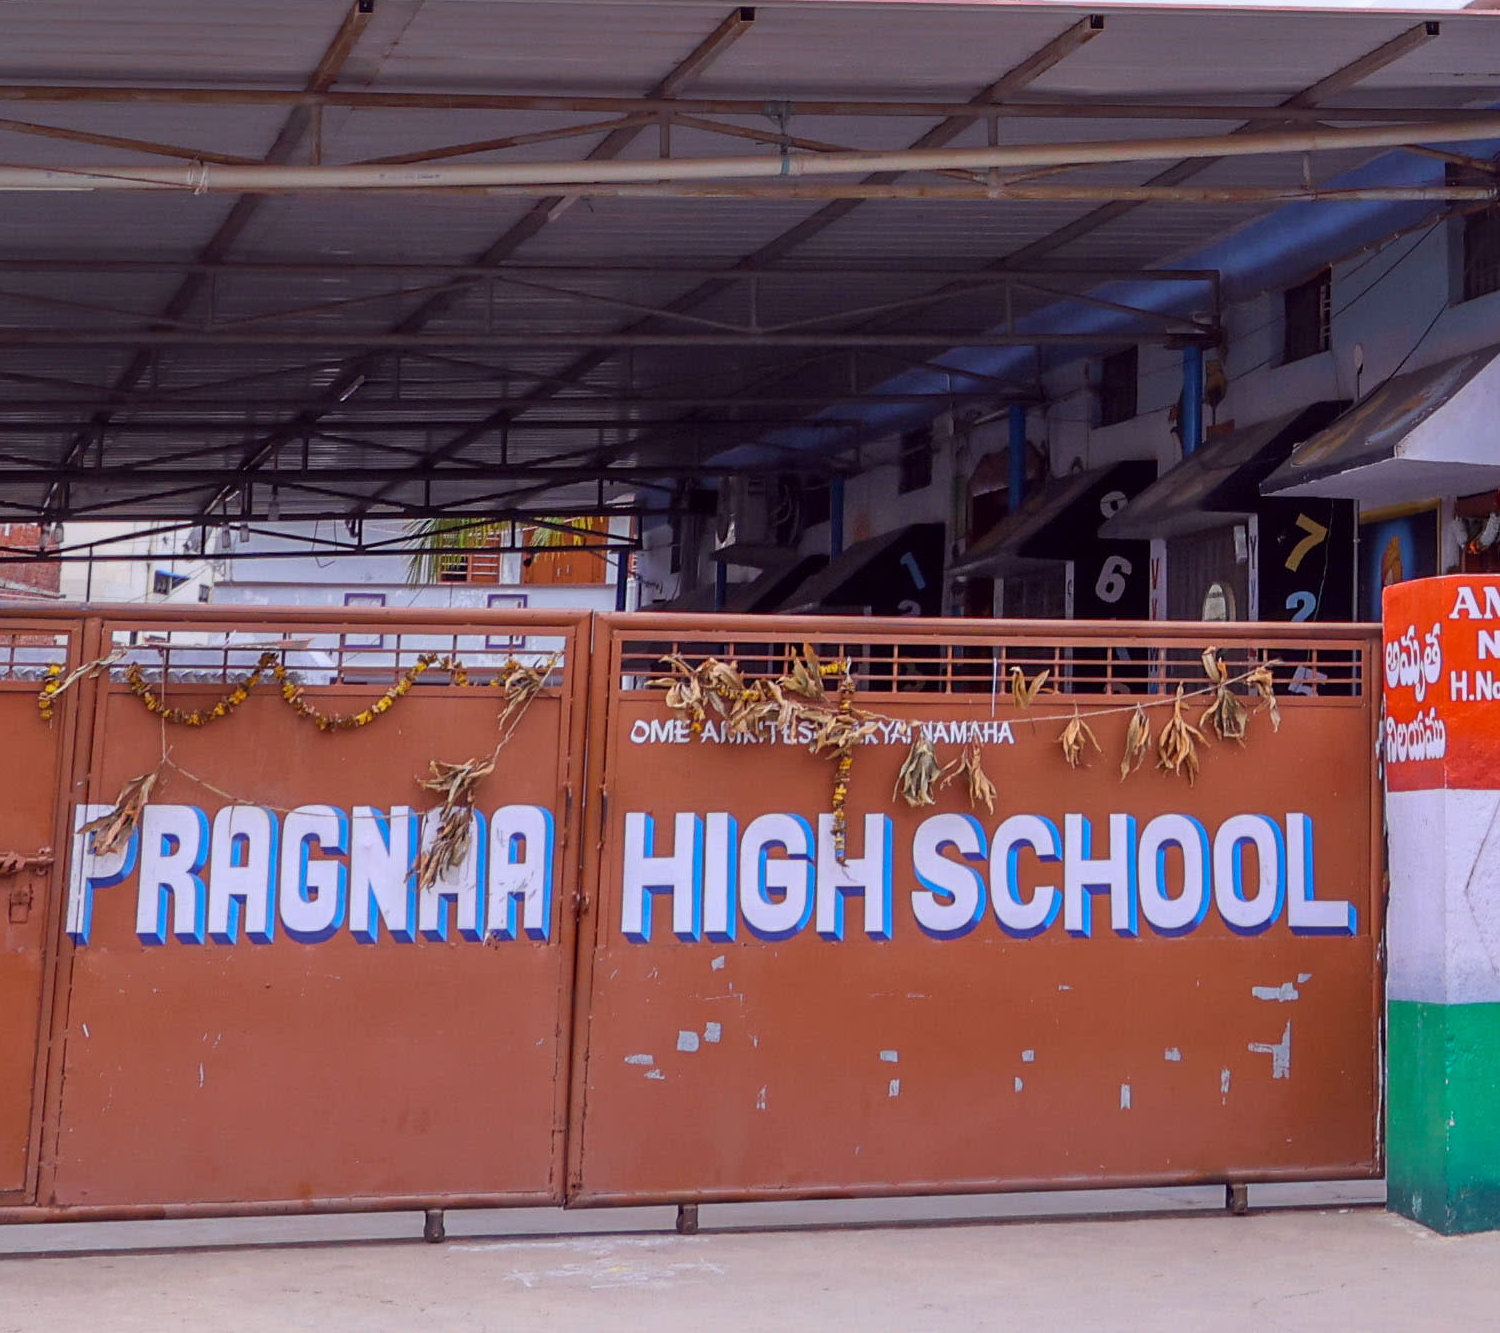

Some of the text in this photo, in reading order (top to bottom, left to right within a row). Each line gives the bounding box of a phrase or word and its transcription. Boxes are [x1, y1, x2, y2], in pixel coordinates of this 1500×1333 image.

[1284, 512, 1329, 573] 7
[1095, 555, 1132, 604] 6
[1385, 622, 1442, 702] అమృత
[630, 718, 691, 745] OME
[65, 803, 1358, 946] PRAGNAA HIGH SCHOOL
